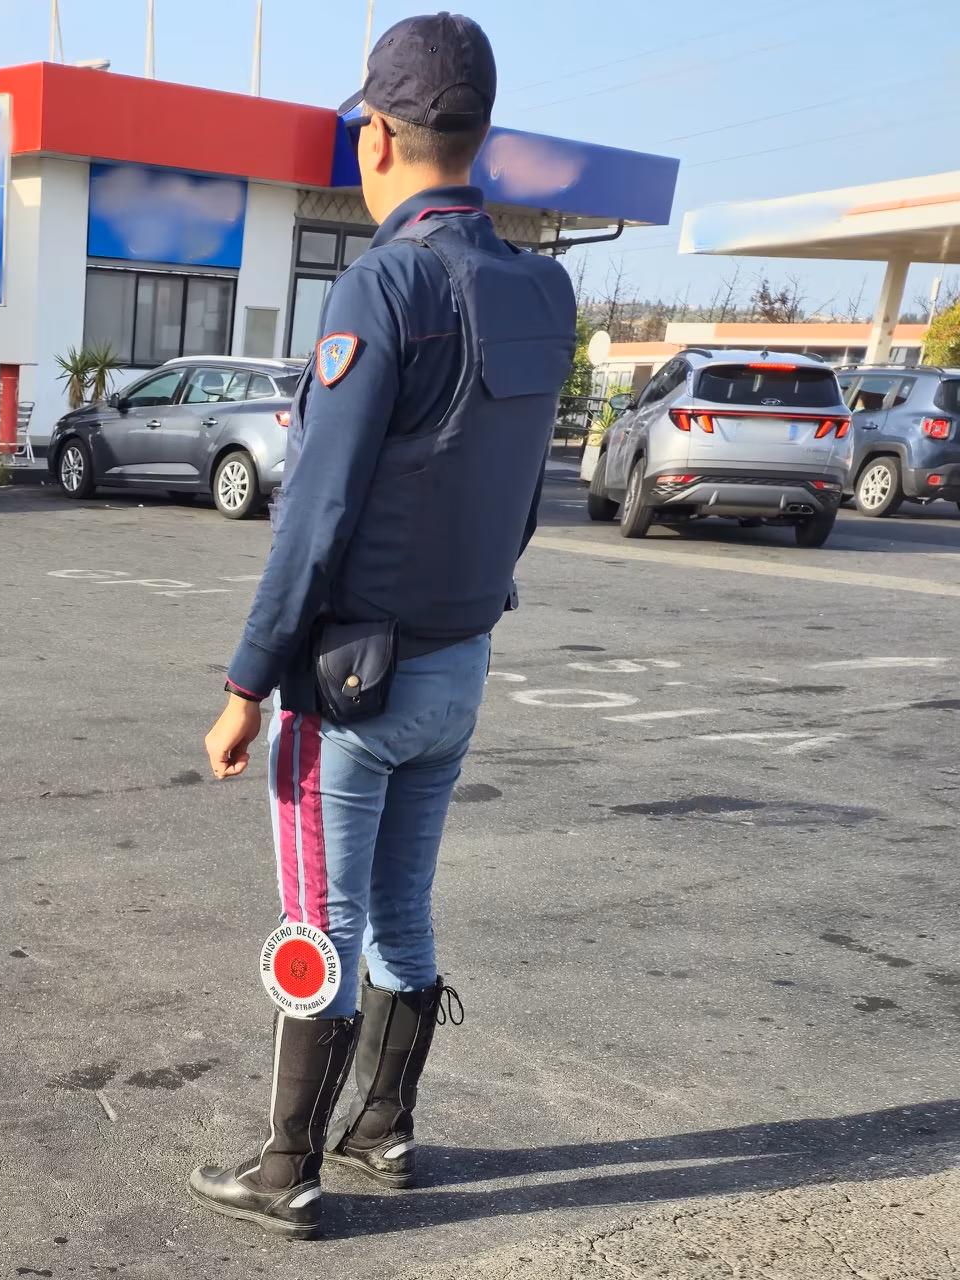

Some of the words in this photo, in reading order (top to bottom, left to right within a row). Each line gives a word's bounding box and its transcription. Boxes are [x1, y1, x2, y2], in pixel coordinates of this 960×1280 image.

[263, 926, 292, 971] MINISTERO
[296, 926, 336, 984] DELL'INTERNO
[270, 986, 292, 1008] POLIZIA
[295, 995, 327, 1011] STRADALE
